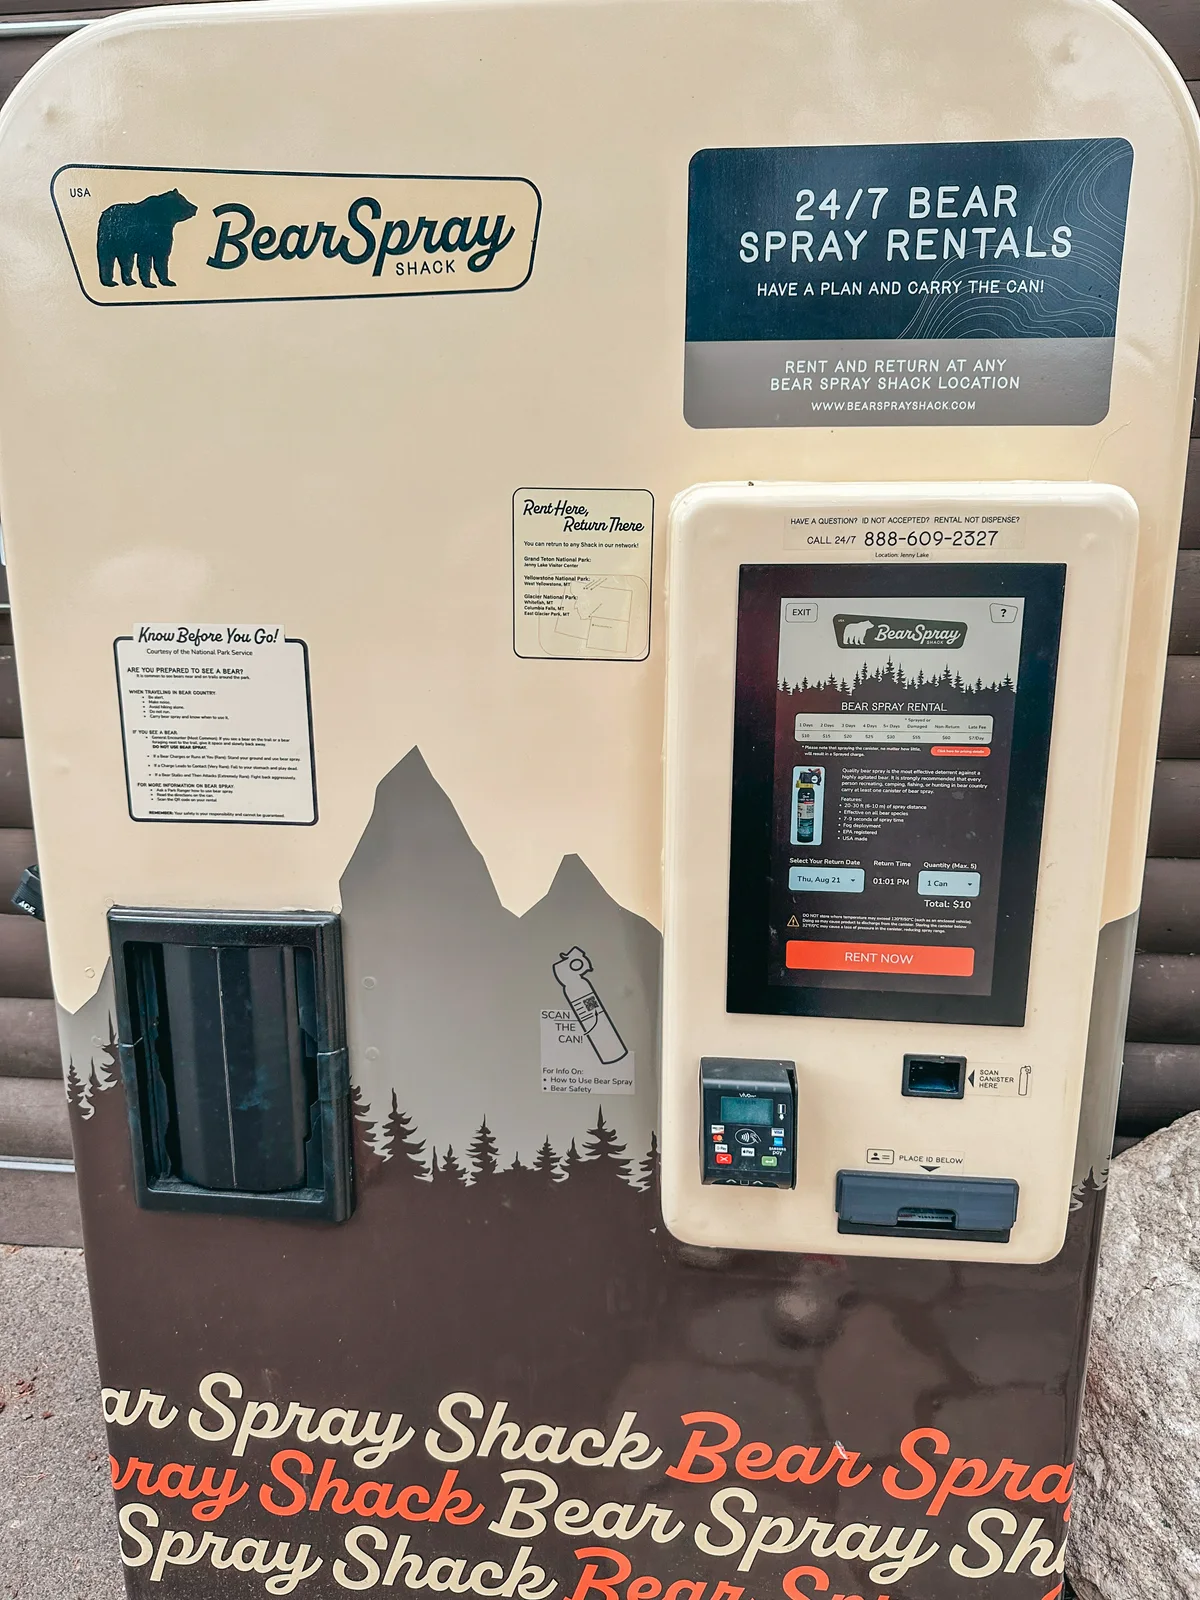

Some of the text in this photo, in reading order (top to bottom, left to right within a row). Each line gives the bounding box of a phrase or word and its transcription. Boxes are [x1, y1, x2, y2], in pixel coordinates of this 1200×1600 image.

[69, 188, 91, 197] USA
[796, 185, 1017, 221] 24/7 BEAR
[740, 226, 1074, 263] SPRAY RENTALS
[395, 259, 456, 276] SHACK
[757, 280, 1044, 296] HAVE A PLAN AND CARRY THE CAN!
[786, 359, 1007, 373] RENT AND RETURN AT ANY
[771, 376, 1019, 391] BEAR SPRAY SHACK LOCATION
[811, 400, 976, 411] WWW.BEARSPRAYSHACK.COM
[523, 499, 589, 517] Rent Here,
[563, 516, 645, 533] Return There
[807, 531, 999, 546] CALL 24/7 888-609-2327
[1001, 609, 1007, 617] ?
[138, 627, 279, 646] Know Before You Go!
[842, 702, 947, 711] BEAR SPRAY RENTAL
[924, 900, 971, 909] Total: $10
[845, 952, 913, 964] RENT NOW
[542, 1011, 570, 1019] SCAN
[555, 1023, 576, 1031] THE
[980, 1069, 999, 1077] SCAN
[612, 1078, 633, 1086] Spray
[569, 1086, 591, 1094] Safety
[188, 1371, 416, 1469] Spray
[424, 1391, 664, 1470] Shack
[665, 1411, 874, 1488] Bear
[882, 1426, 1076, 1522] Spra
[258, 1449, 485, 1526] Shack
[488, 1468, 685, 1543] Bear
[694, 1487, 940, 1585] Spray
[118, 1502, 323, 1596] Spray
[332, 1524, 559, 1600] Shack
